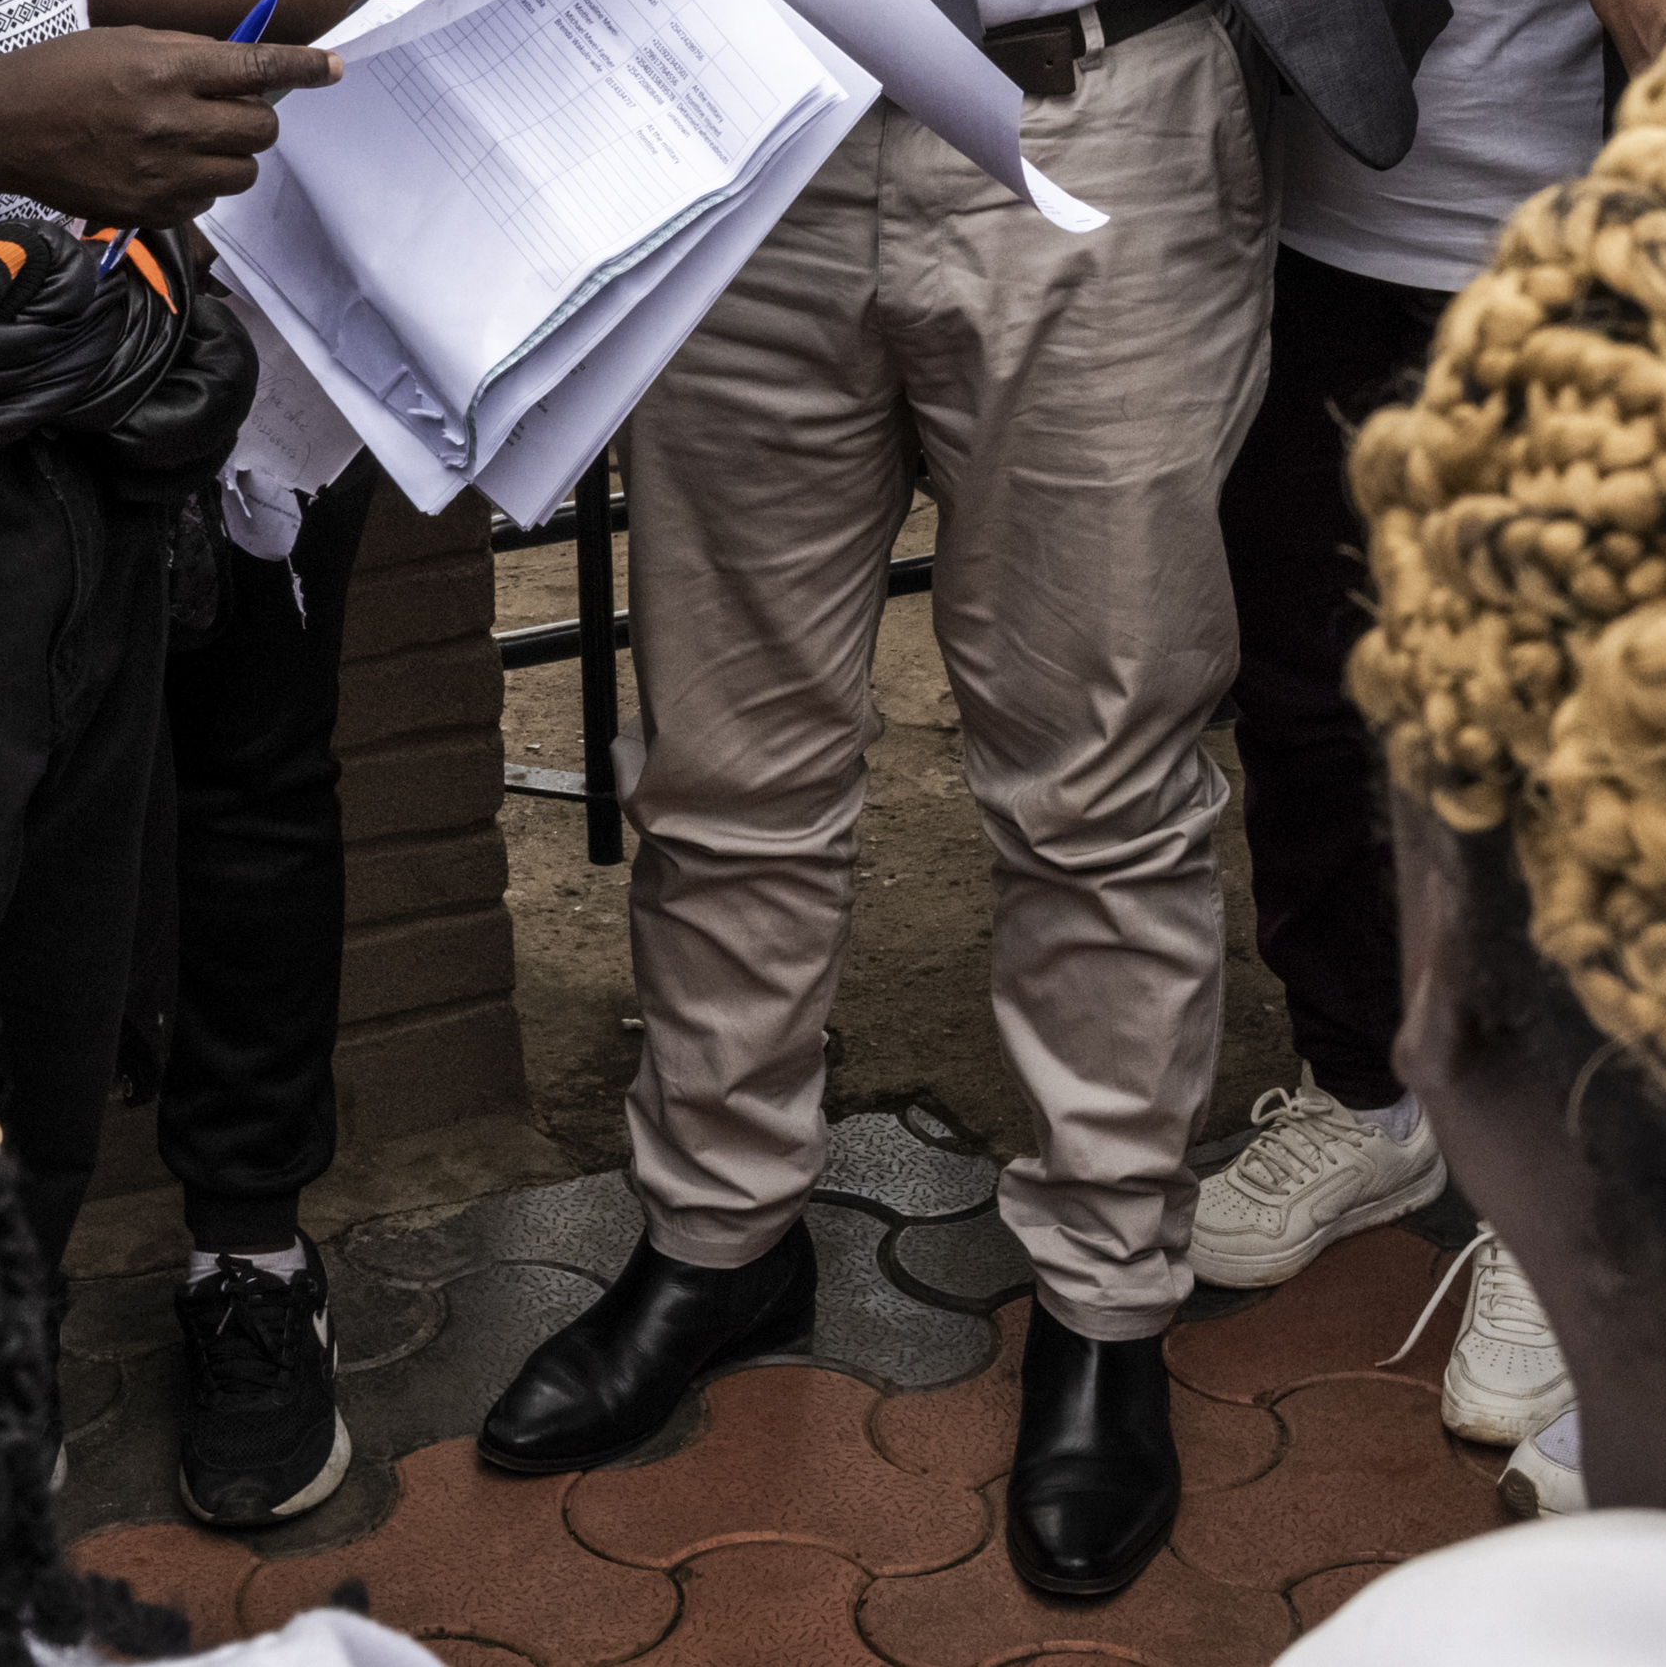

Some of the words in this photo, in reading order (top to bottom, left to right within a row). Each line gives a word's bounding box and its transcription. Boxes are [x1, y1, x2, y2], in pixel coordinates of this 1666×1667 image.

[563, 9, 586, 35] Michael
[553, 17, 574, 40] Brenda
[645, 122, 655, 132] At
[653, 132, 663, 142] the
[659, 140, 682, 165] military
[572, 2, 594, 26] Mother
[666, 110, 691, 138] unknown
[683, 92, 706, 119] frontline
[701, 115, 722, 138] injured
[691, 84, 700, 93] At
[698, 93, 708, 103] the
[703, 100, 725, 123] military
[634, 128, 659, 156] frontline
[675, 102, 730, 165] Detained/whereabouts
